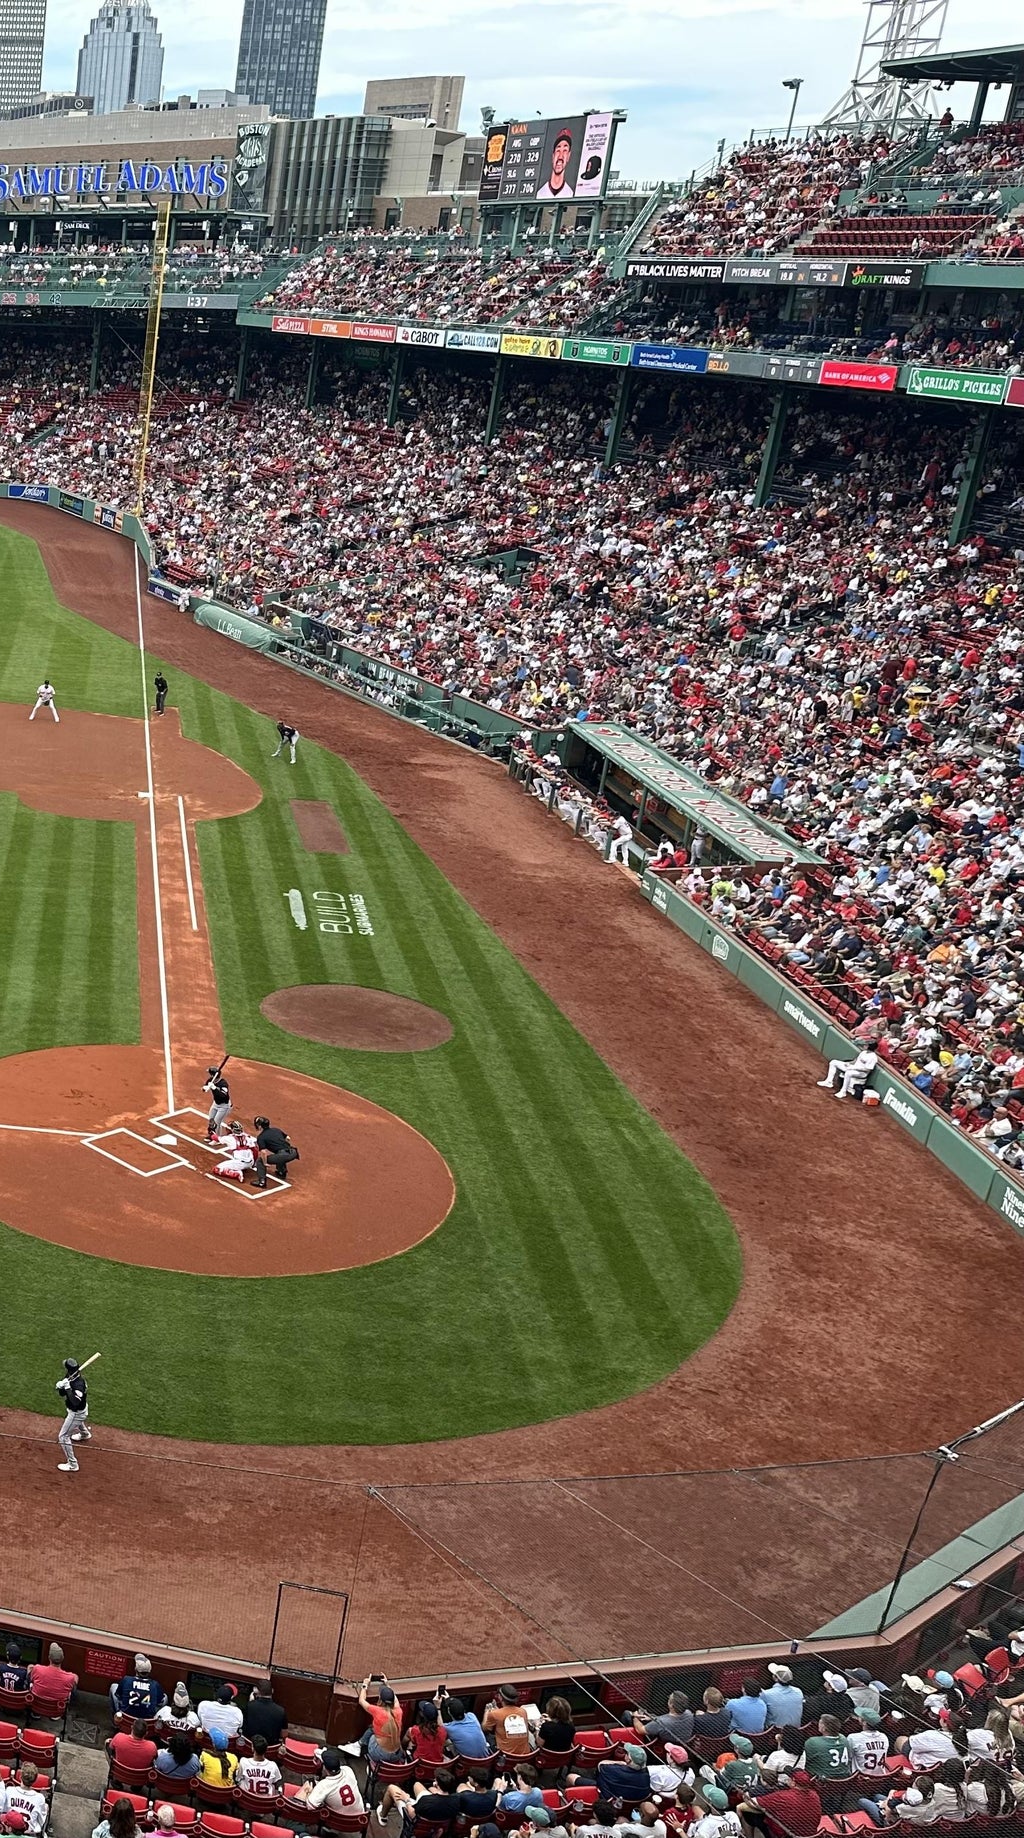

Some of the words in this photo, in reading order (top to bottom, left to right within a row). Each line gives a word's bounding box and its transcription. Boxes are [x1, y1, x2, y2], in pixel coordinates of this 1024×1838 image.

[239, 125, 271, 138] BOSTON
[512, 124, 528, 135] KWAN
[235, 154, 266, 168] ACADEMY
[507, 154, 521, 164] .270
[525, 152, 540, 163] .329
[116, 159, 228, 197] ADAMS
[503, 184, 516, 195] .377
[520, 183, 534, 194] .706
[639, 265, 665, 276] BLACK
[666, 266, 689, 277] LIVES
[689, 266, 723, 278] MATTER
[731, 268, 749, 277] PITCH
[750, 268, 771, 278] BREAK
[852, 275, 911, 286] DRAFTKINGS
[187, 296, 208, 308] 1:37
[850, 373, 876, 383] AMERICA
[923, 376, 960, 391] GRILLO'S
[962, 380, 1002, 396] PICKLES
[313, 891, 354, 934] BUILD
[784, 1000, 821, 1038] smartwater
[883, 1086, 918, 1127] franklin
[88, 1650, 127, 1663] CAUTION!
[129, 1691, 152, 1706] 24
[865, 1741, 885, 1751] ORTIZ
[828, 1748, 849, 1767] 34
[864, 1753, 886, 1770] 34
[246, 1768, 271, 1779] DURAN
[247, 1780, 270, 1795] 16
[339, 1784, 355, 1806] 8
[11, 1797, 35, 1813] DURAN
